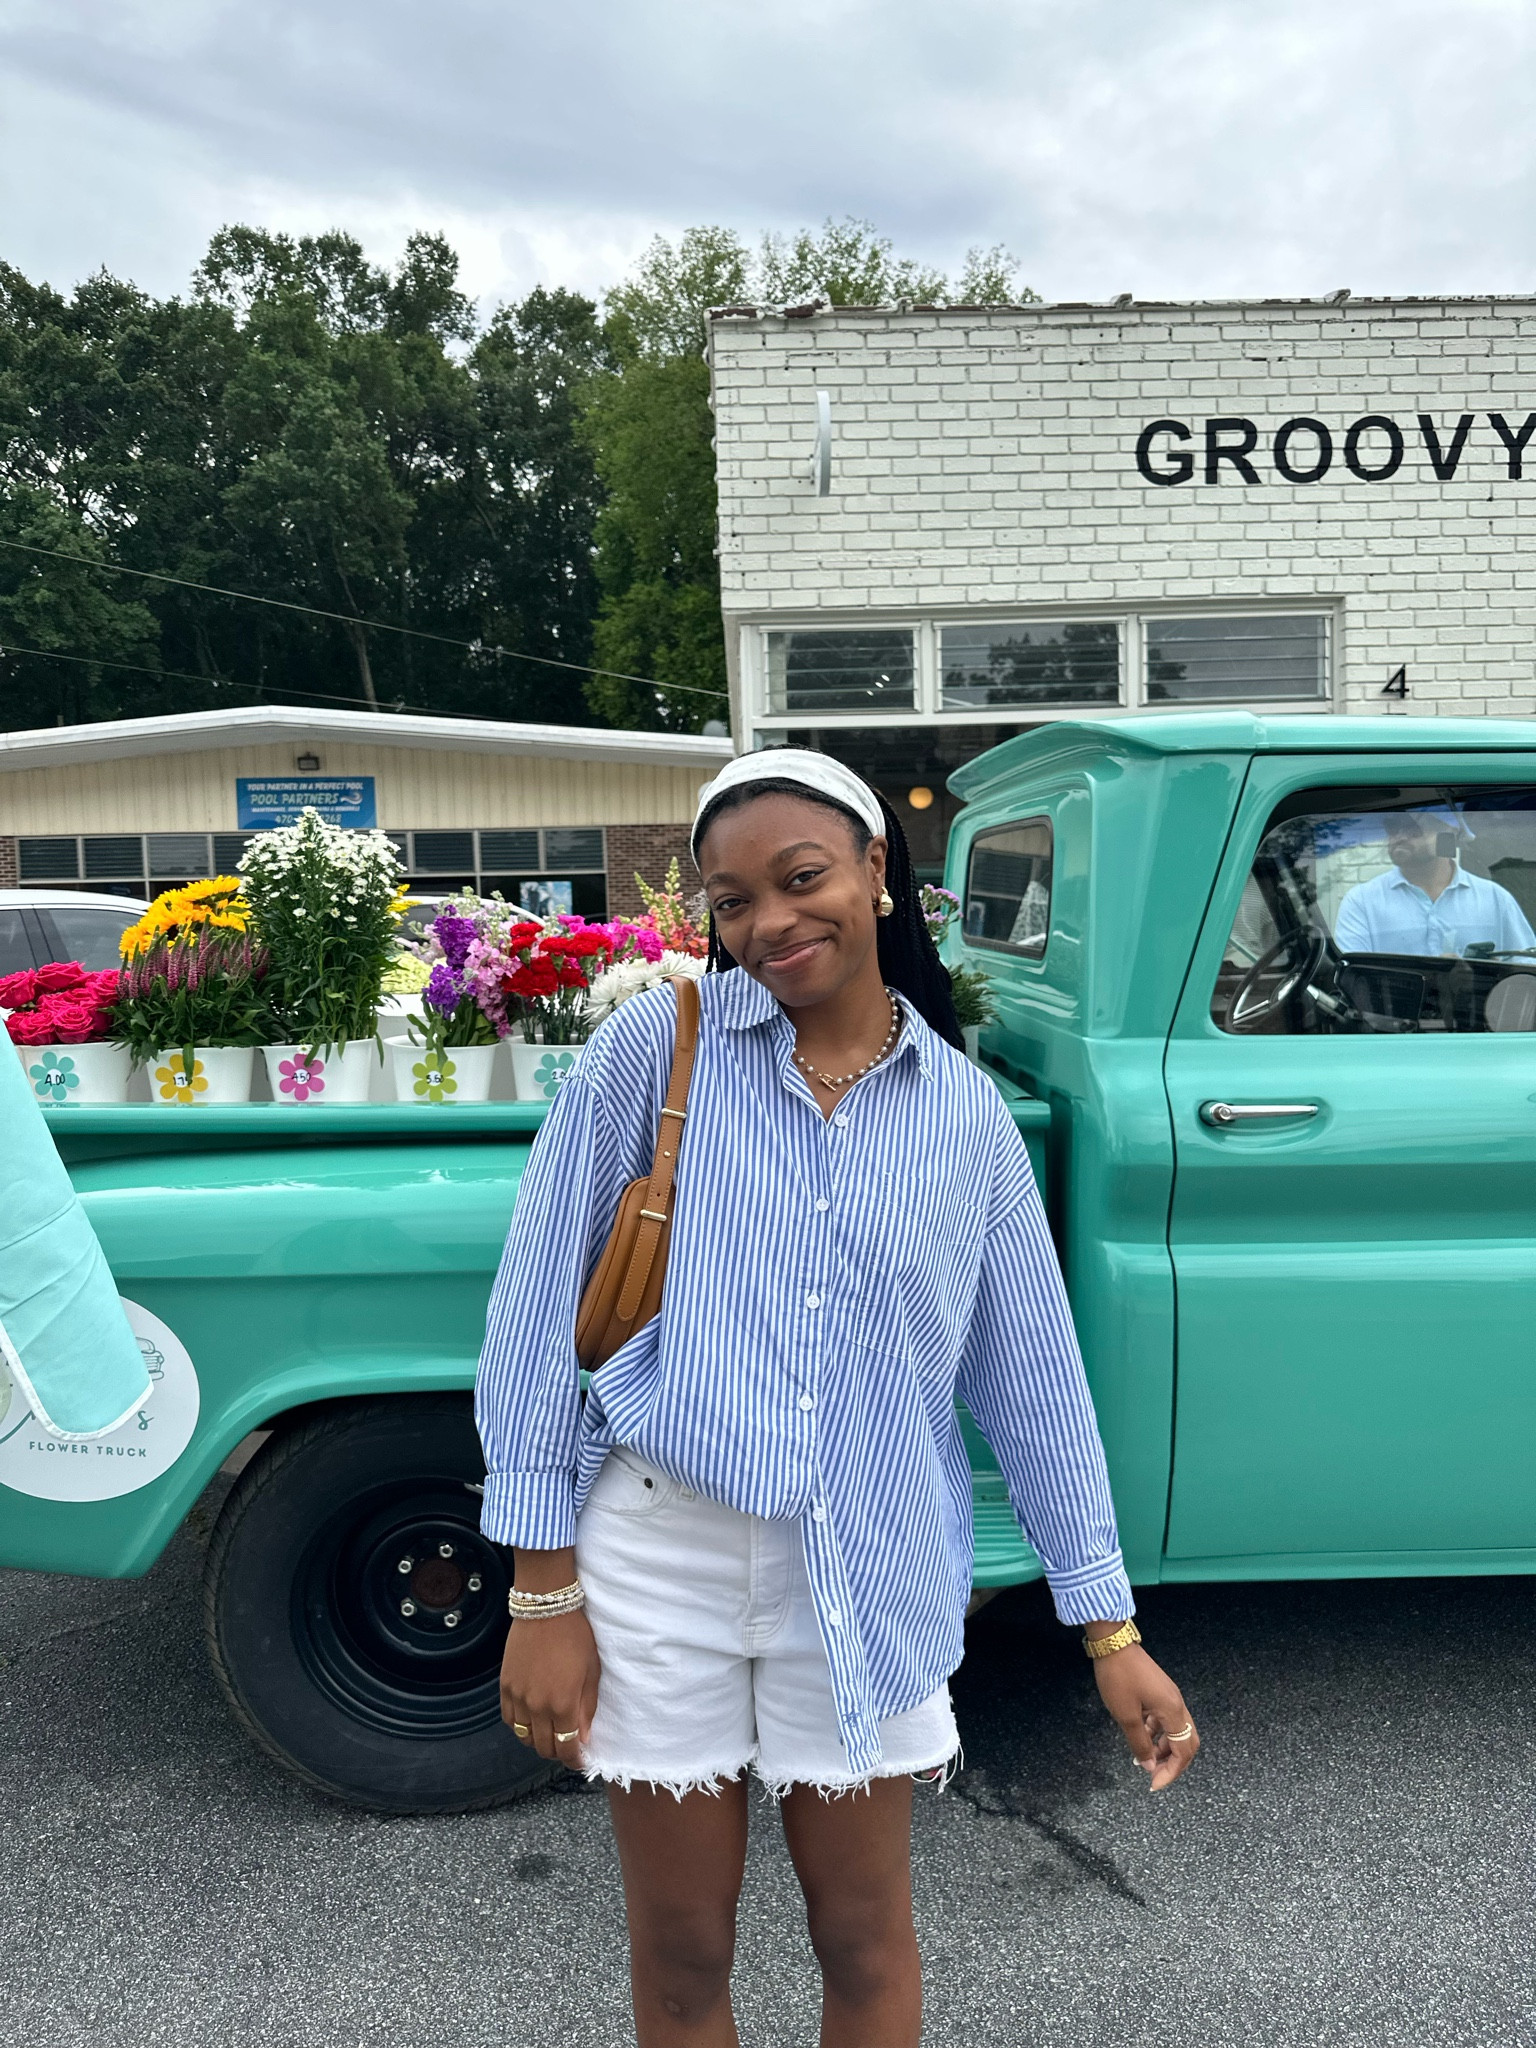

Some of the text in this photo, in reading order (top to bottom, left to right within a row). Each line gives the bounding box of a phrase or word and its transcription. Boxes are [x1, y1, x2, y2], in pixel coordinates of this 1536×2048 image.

[1136, 413, 1536, 486] GROOVY
[1380, 663, 1410, 699] 4
[247, 783, 265, 791] YOUR
[267, 782, 298, 791] PARTNER
[299, 782, 308, 790] IN
[315, 781, 345, 790] PERFECT
[346, 781, 364, 790] POOL
[250, 792, 340, 805] POOL PARTNERS
[29, 1441, 147, 1458] FLOWER TRUCK
